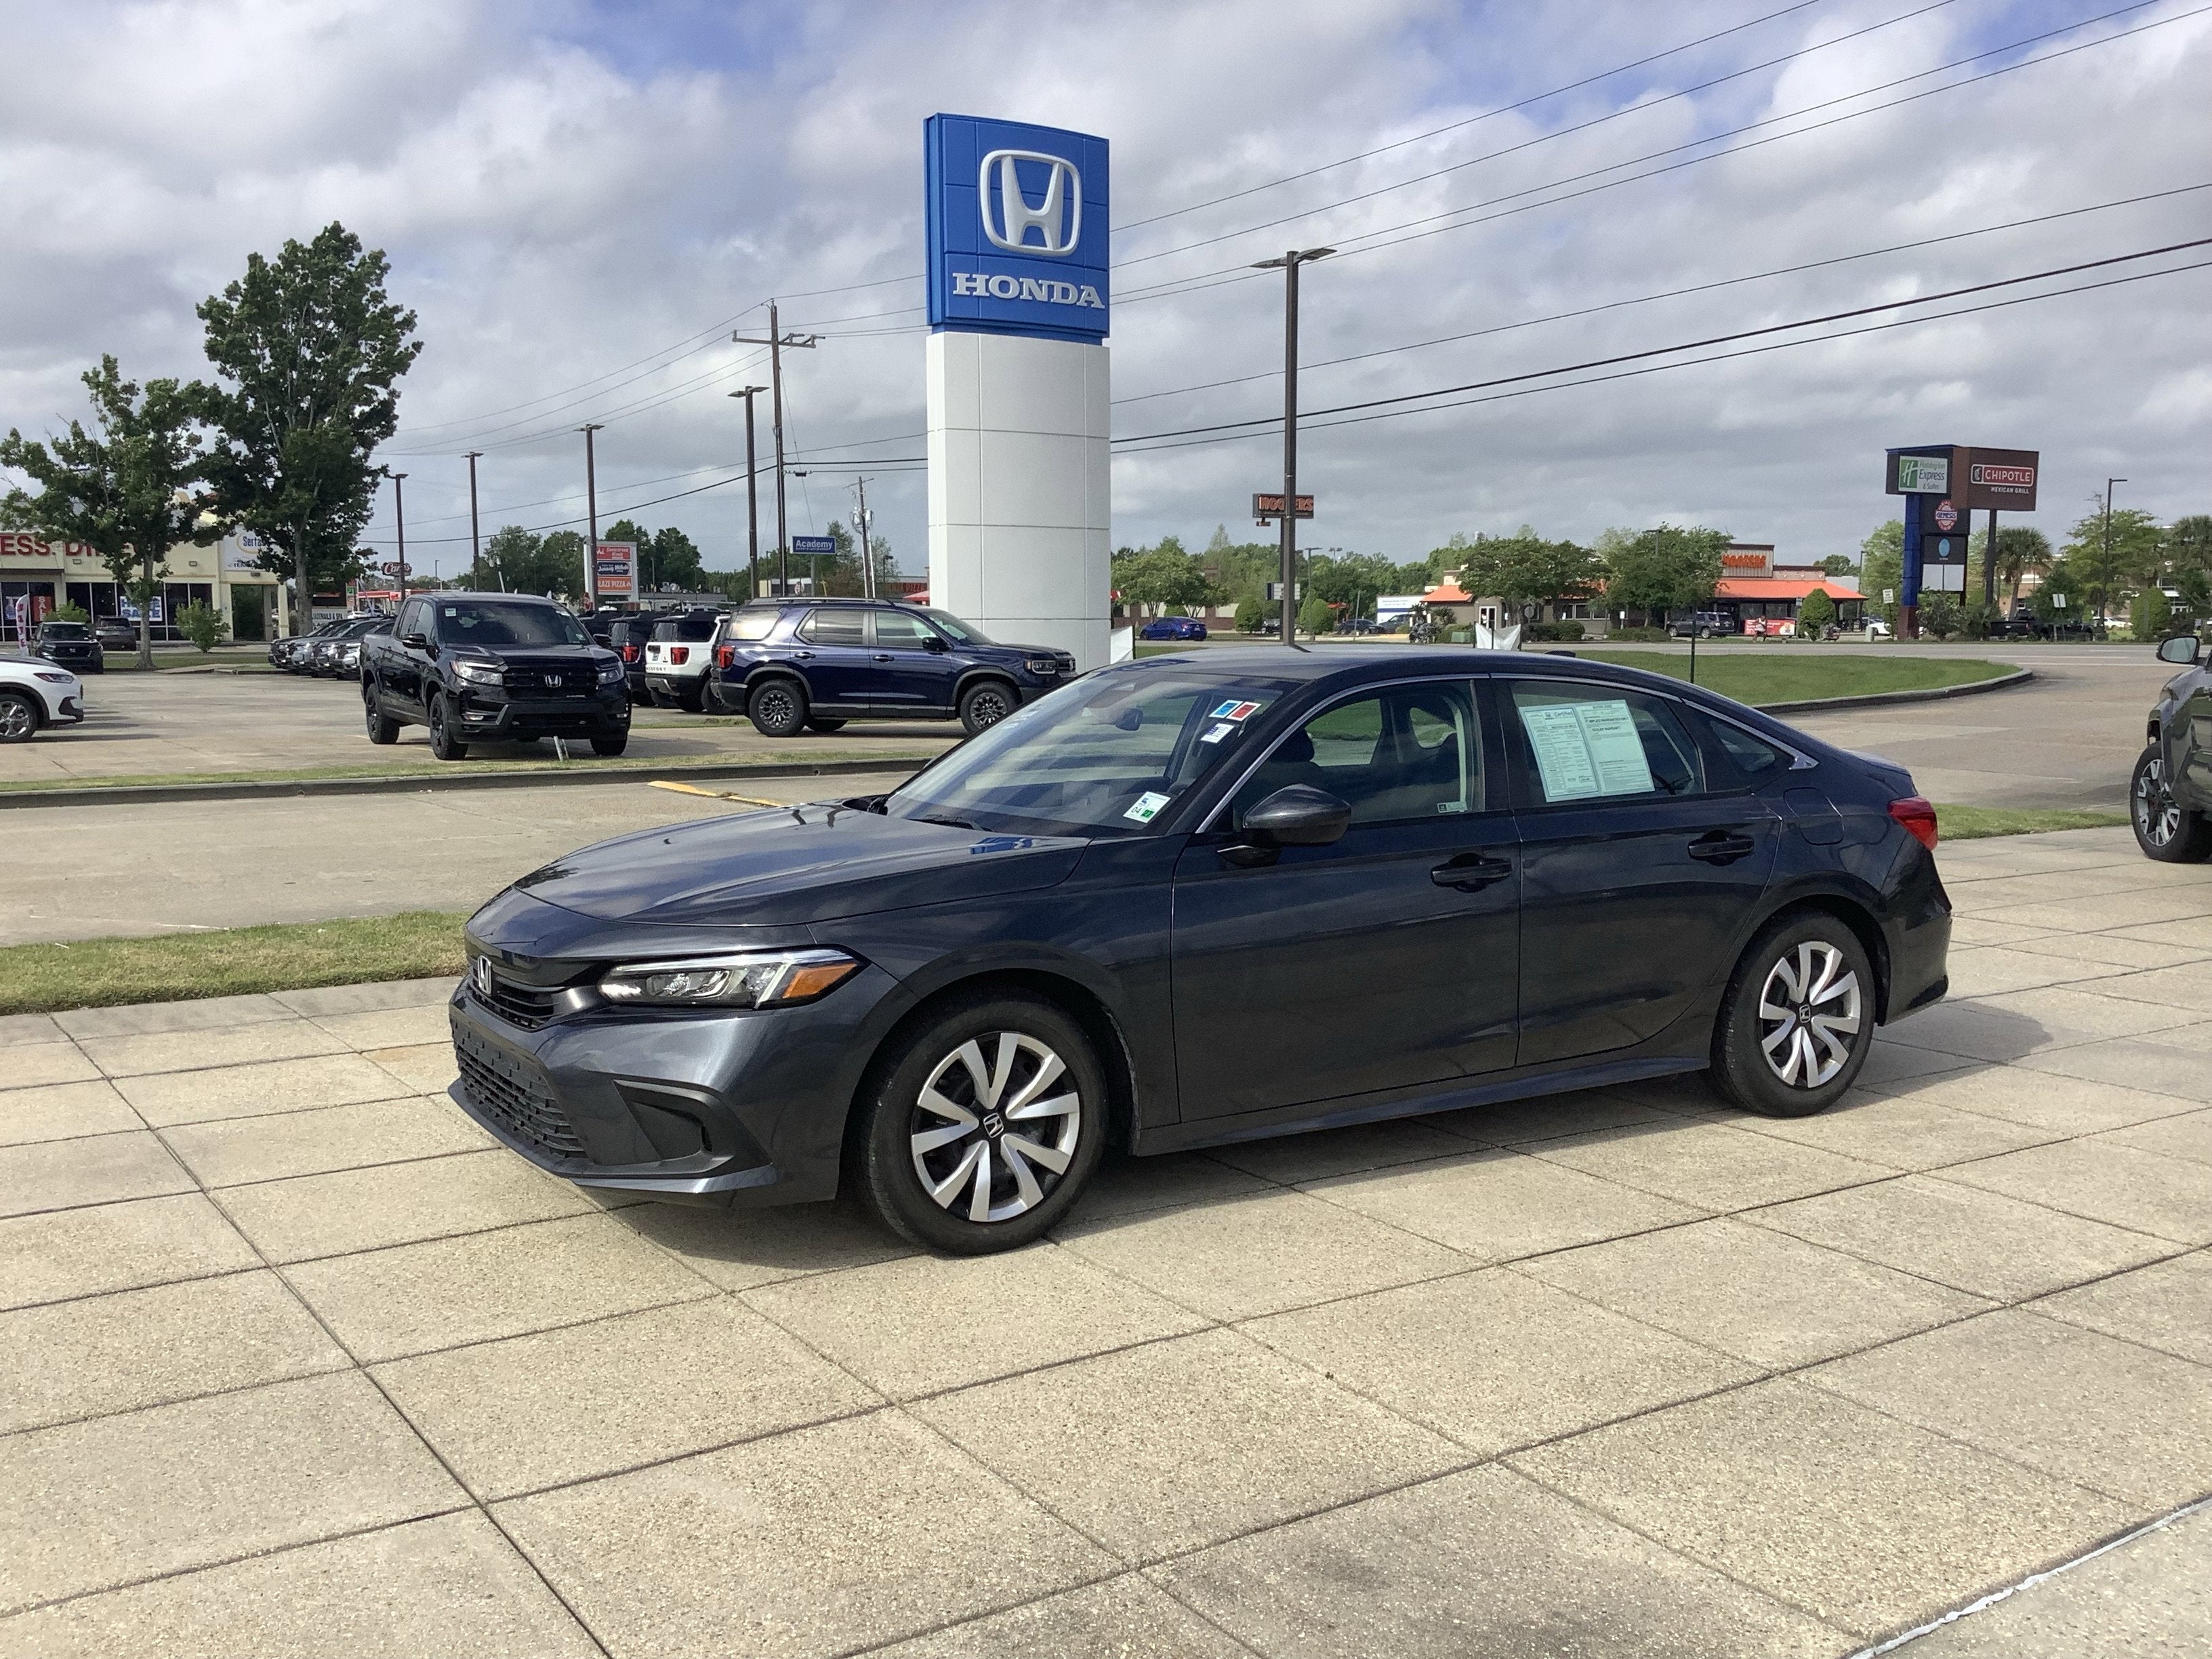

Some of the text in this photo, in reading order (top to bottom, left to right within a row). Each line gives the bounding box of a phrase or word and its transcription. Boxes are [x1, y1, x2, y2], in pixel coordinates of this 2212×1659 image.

[952, 272, 1105, 309] HONDA
[1919, 469, 1945, 482] Express
[1985, 470, 2030, 482] CHIPOTLE
[796, 540, 833, 550] Academy
[122, 609, 161, 617] SAE
